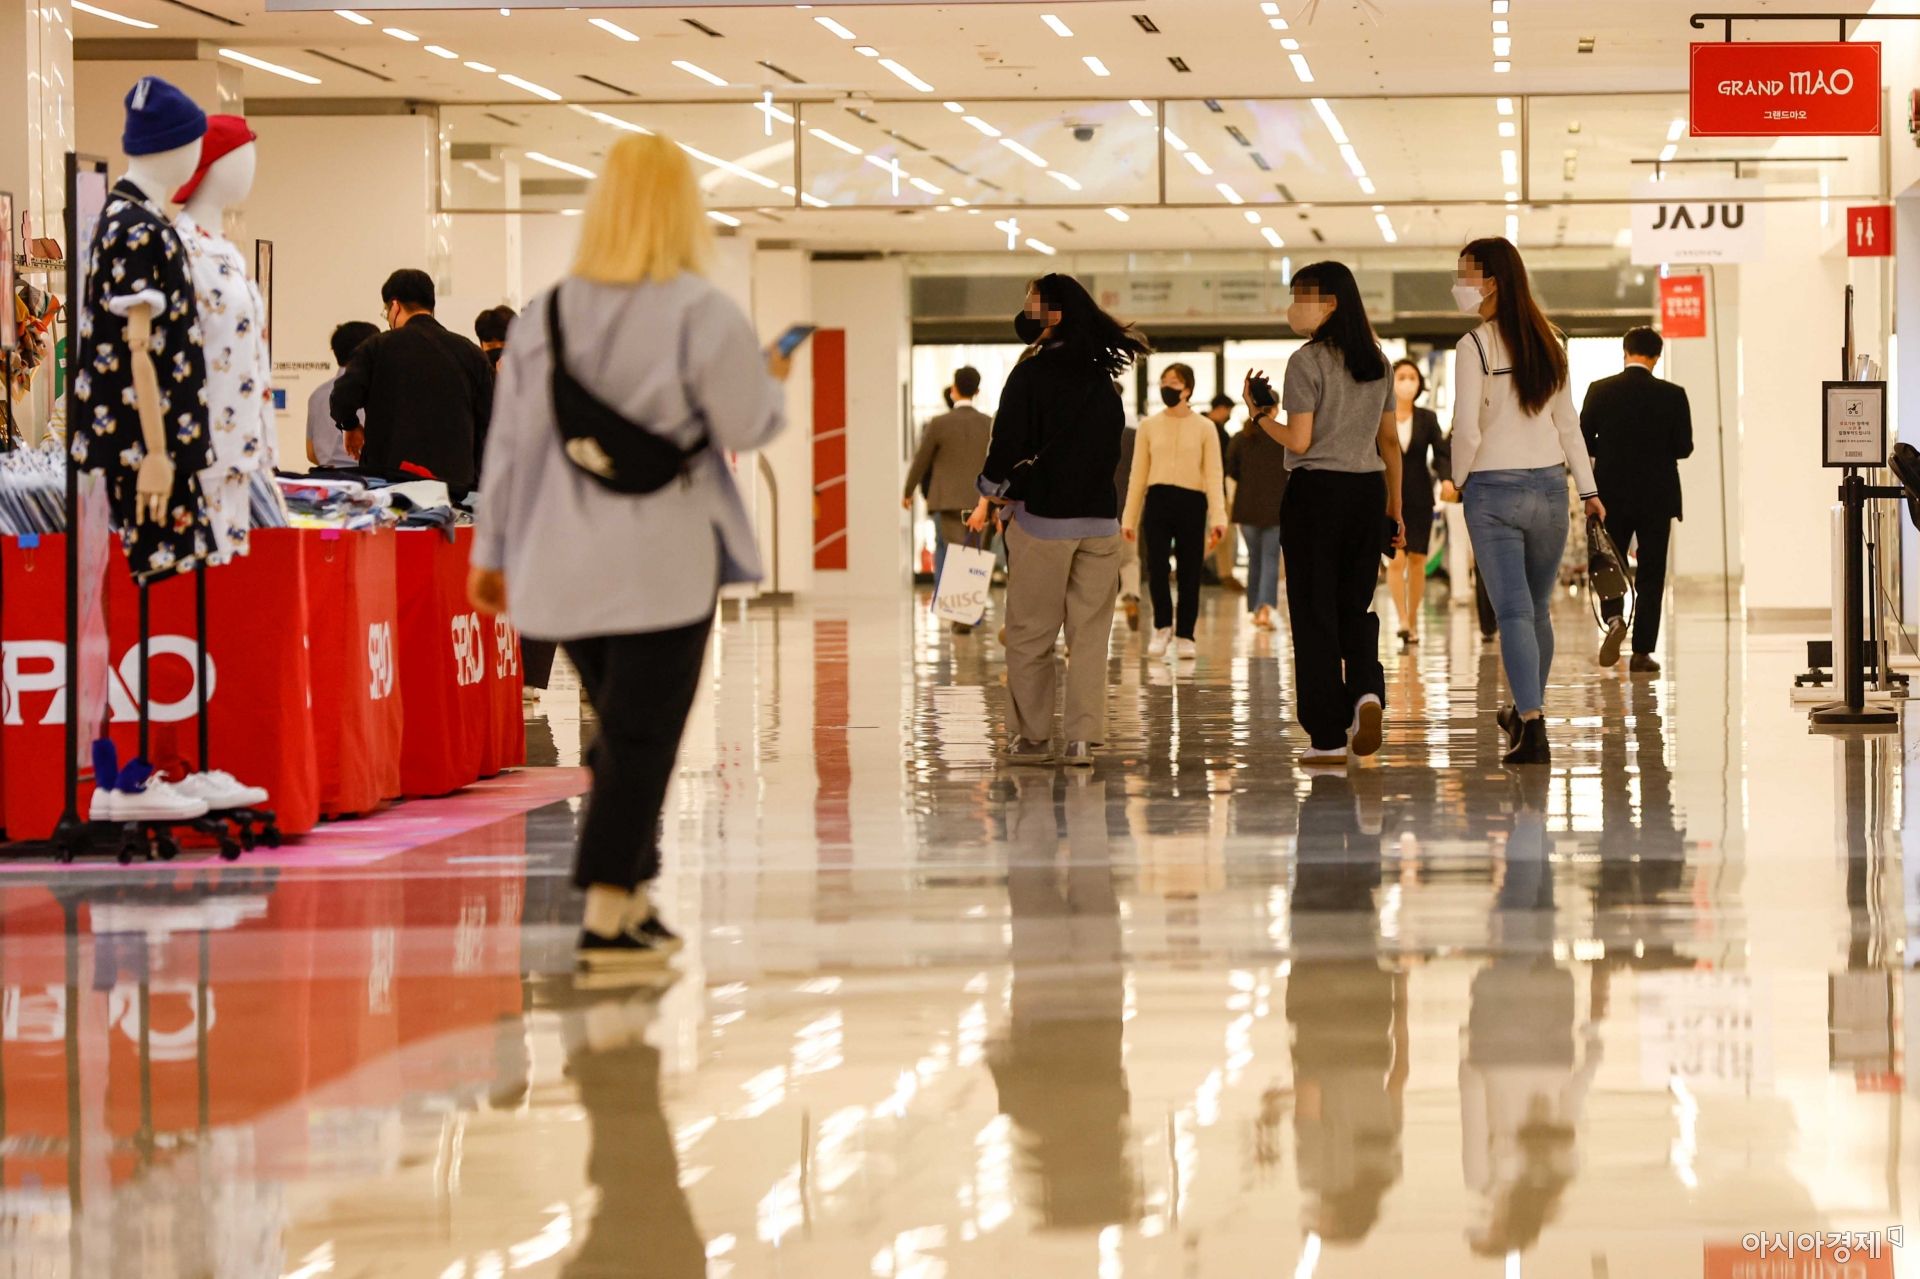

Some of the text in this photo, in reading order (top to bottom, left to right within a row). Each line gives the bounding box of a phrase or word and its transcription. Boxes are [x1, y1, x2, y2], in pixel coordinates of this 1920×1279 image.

[1717, 68, 1854, 96] GRAND MAO
[1763, 110, 1808, 120] 그랜드마오
[1652, 204, 1744, 230] JAJU
